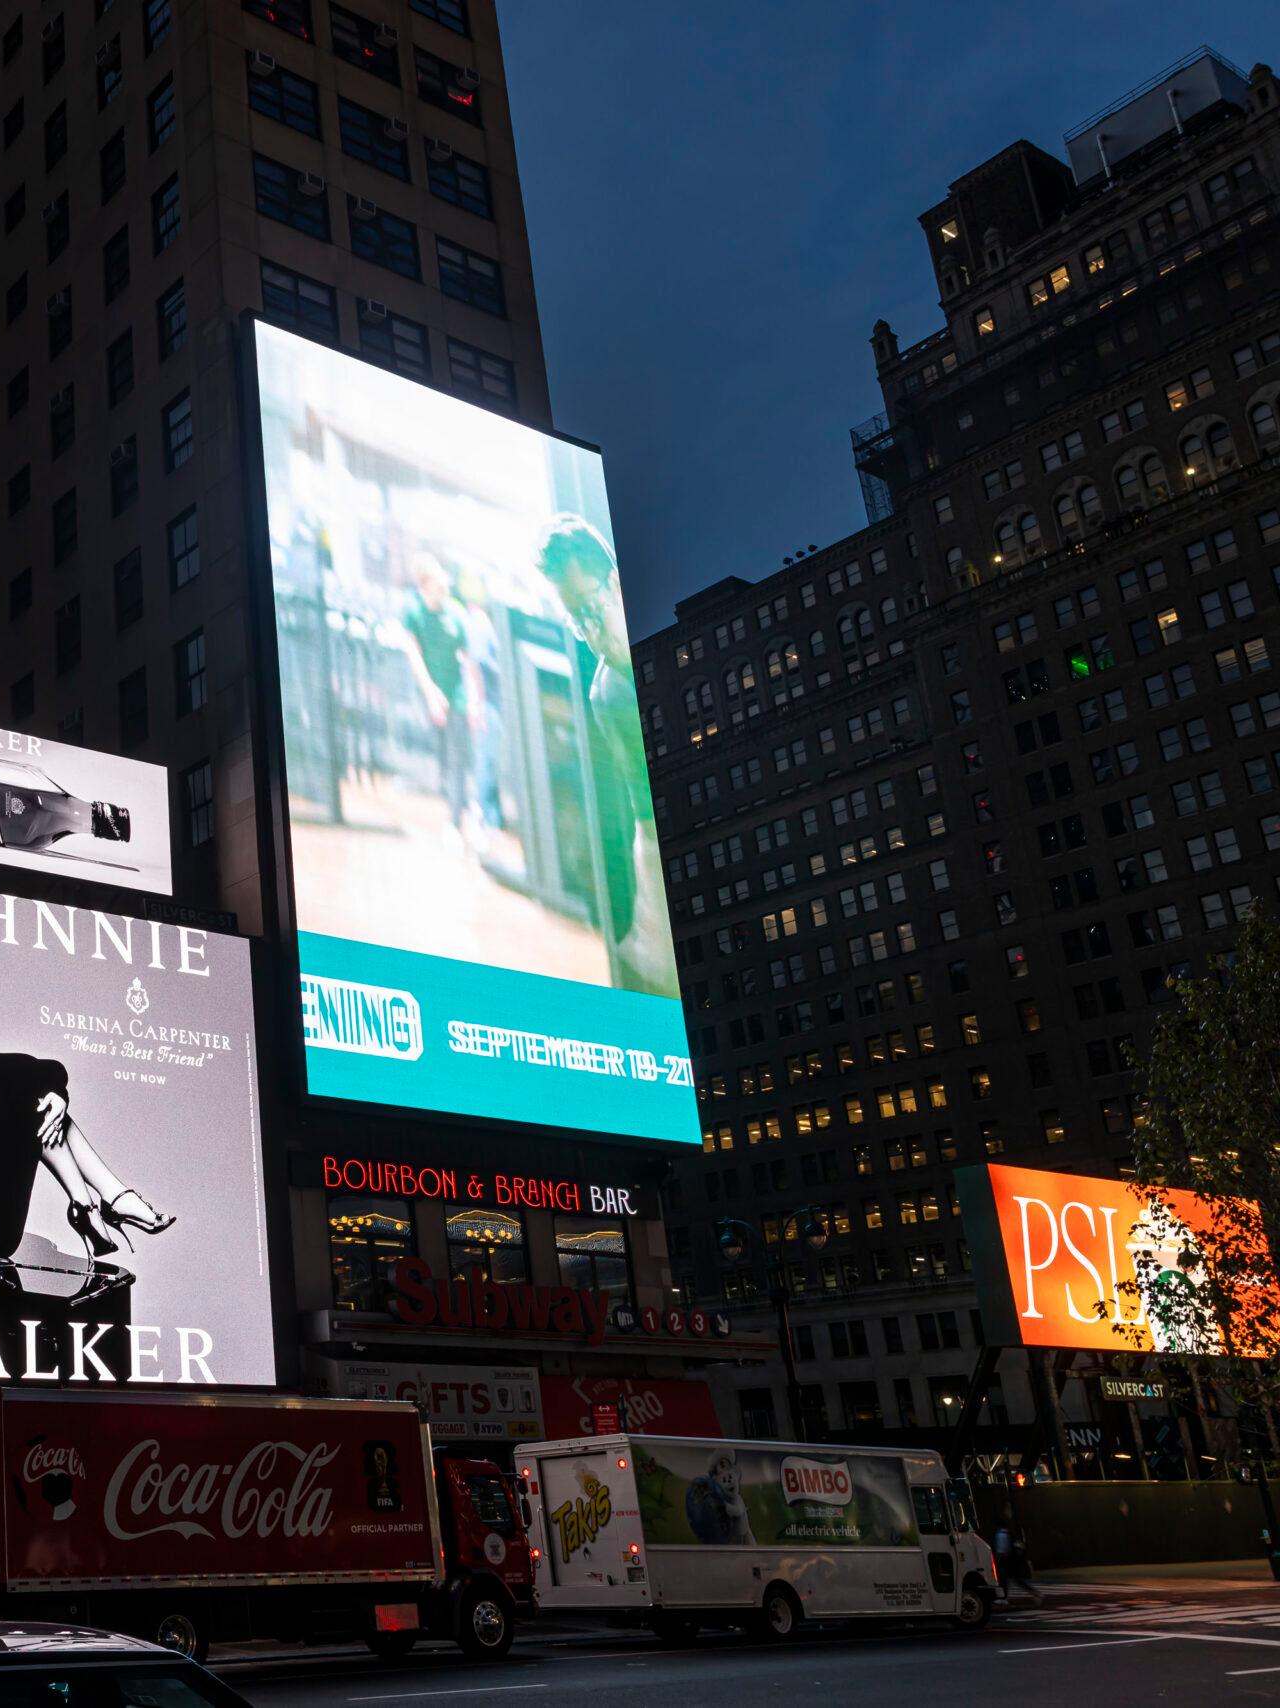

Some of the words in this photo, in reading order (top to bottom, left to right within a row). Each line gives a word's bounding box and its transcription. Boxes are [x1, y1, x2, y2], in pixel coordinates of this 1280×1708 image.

[40, 1005, 123, 1036] SABRINA
[129, 1019, 232, 1051] CARPENTER
[121, 1041, 152, 1061] Best
[114, 1070, 136, 1081] OUT
[141, 1073, 166, 1085] NOW
[323, 1154, 457, 1200] BOURBON
[467, 1176, 484, 1199] &
[494, 1175, 582, 1213] BRANCH
[590, 1184, 637, 1215] BAR
[1013, 1196, 1146, 1325] PSL
[388, 1256, 610, 1346] Subway
[646, 1311, 655, 1329] 1
[671, 1312, 682, 1331] 2
[695, 1314, 704, 1332] 3
[431, 1423, 466, 1434] UGGAGE
[481, 1423, 503, 1434] NYPD
[103, 1439, 342, 1541] Coca-Cola
[783, 1468, 849, 1494] BIMBO
[376, 1498, 394, 1507] FIFA
[351, 1524, 387, 1534] OFFICIAL
[388, 1523, 424, 1533] PARTNER
[798, 1524, 830, 1536] electric
[831, 1525, 860, 1537] vehicle
